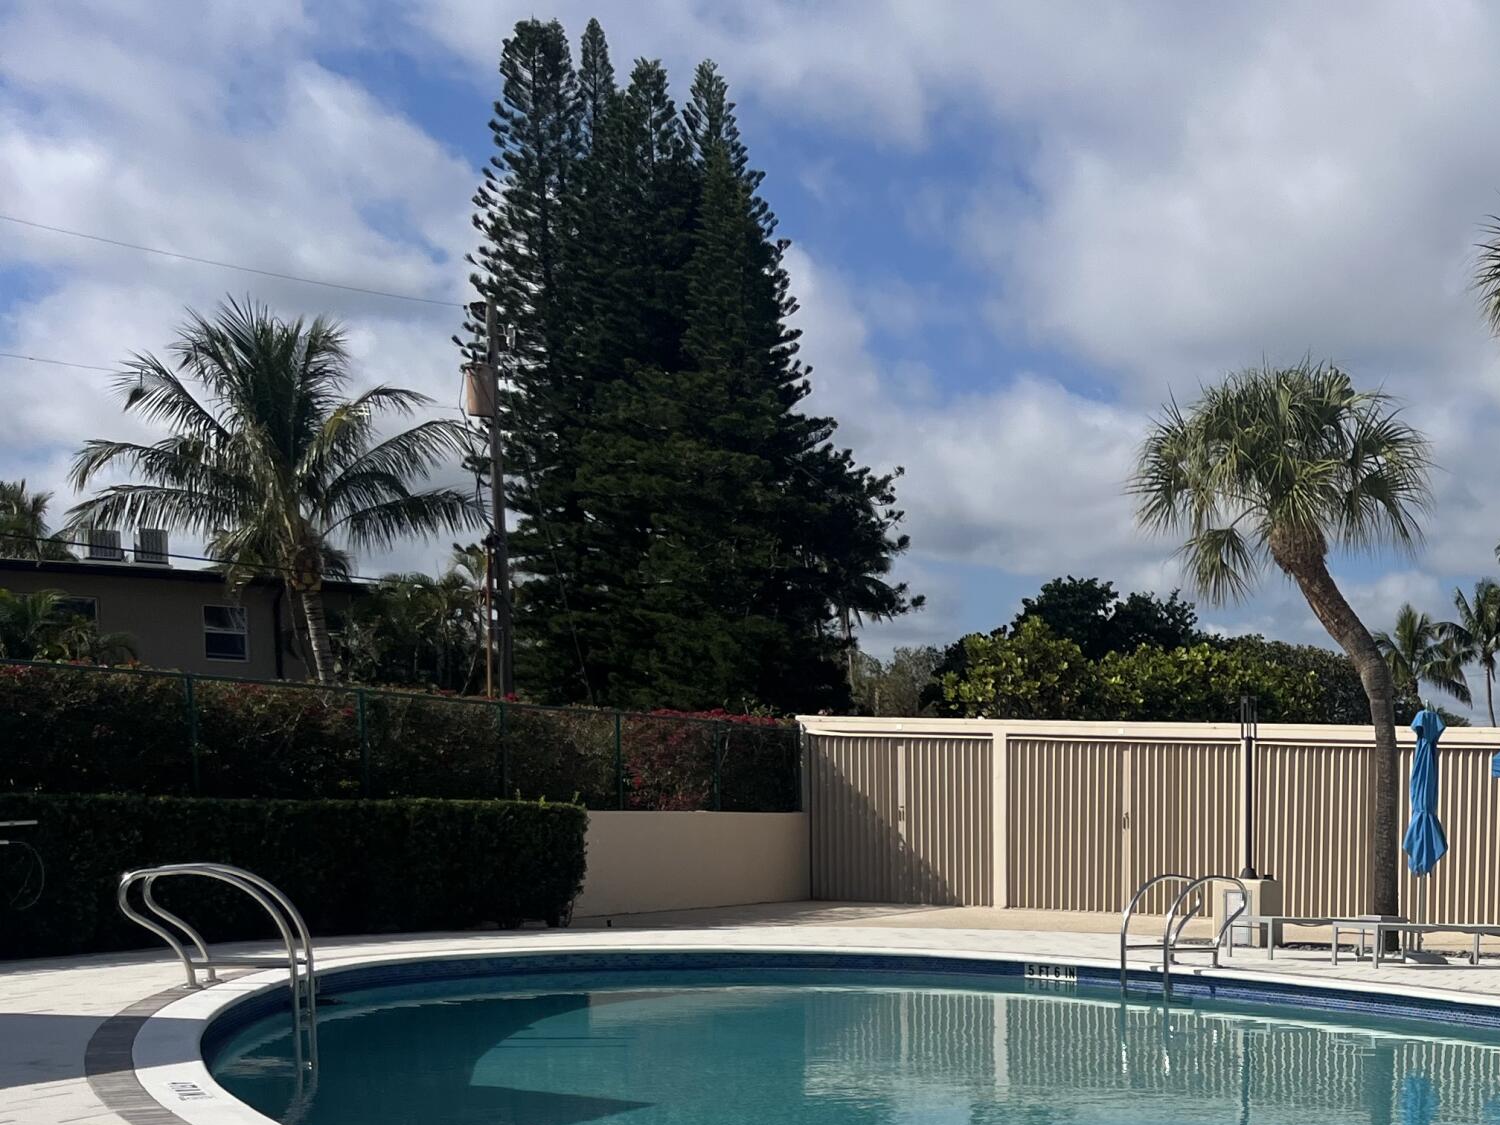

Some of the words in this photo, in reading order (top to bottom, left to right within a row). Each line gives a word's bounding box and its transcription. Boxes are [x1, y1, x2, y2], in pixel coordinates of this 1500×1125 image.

[1028, 964, 1035, 976] 5
[1038, 965, 1050, 977] FT
[1054, 966, 1061, 978] 6
[1065, 967, 1075, 979] IN
